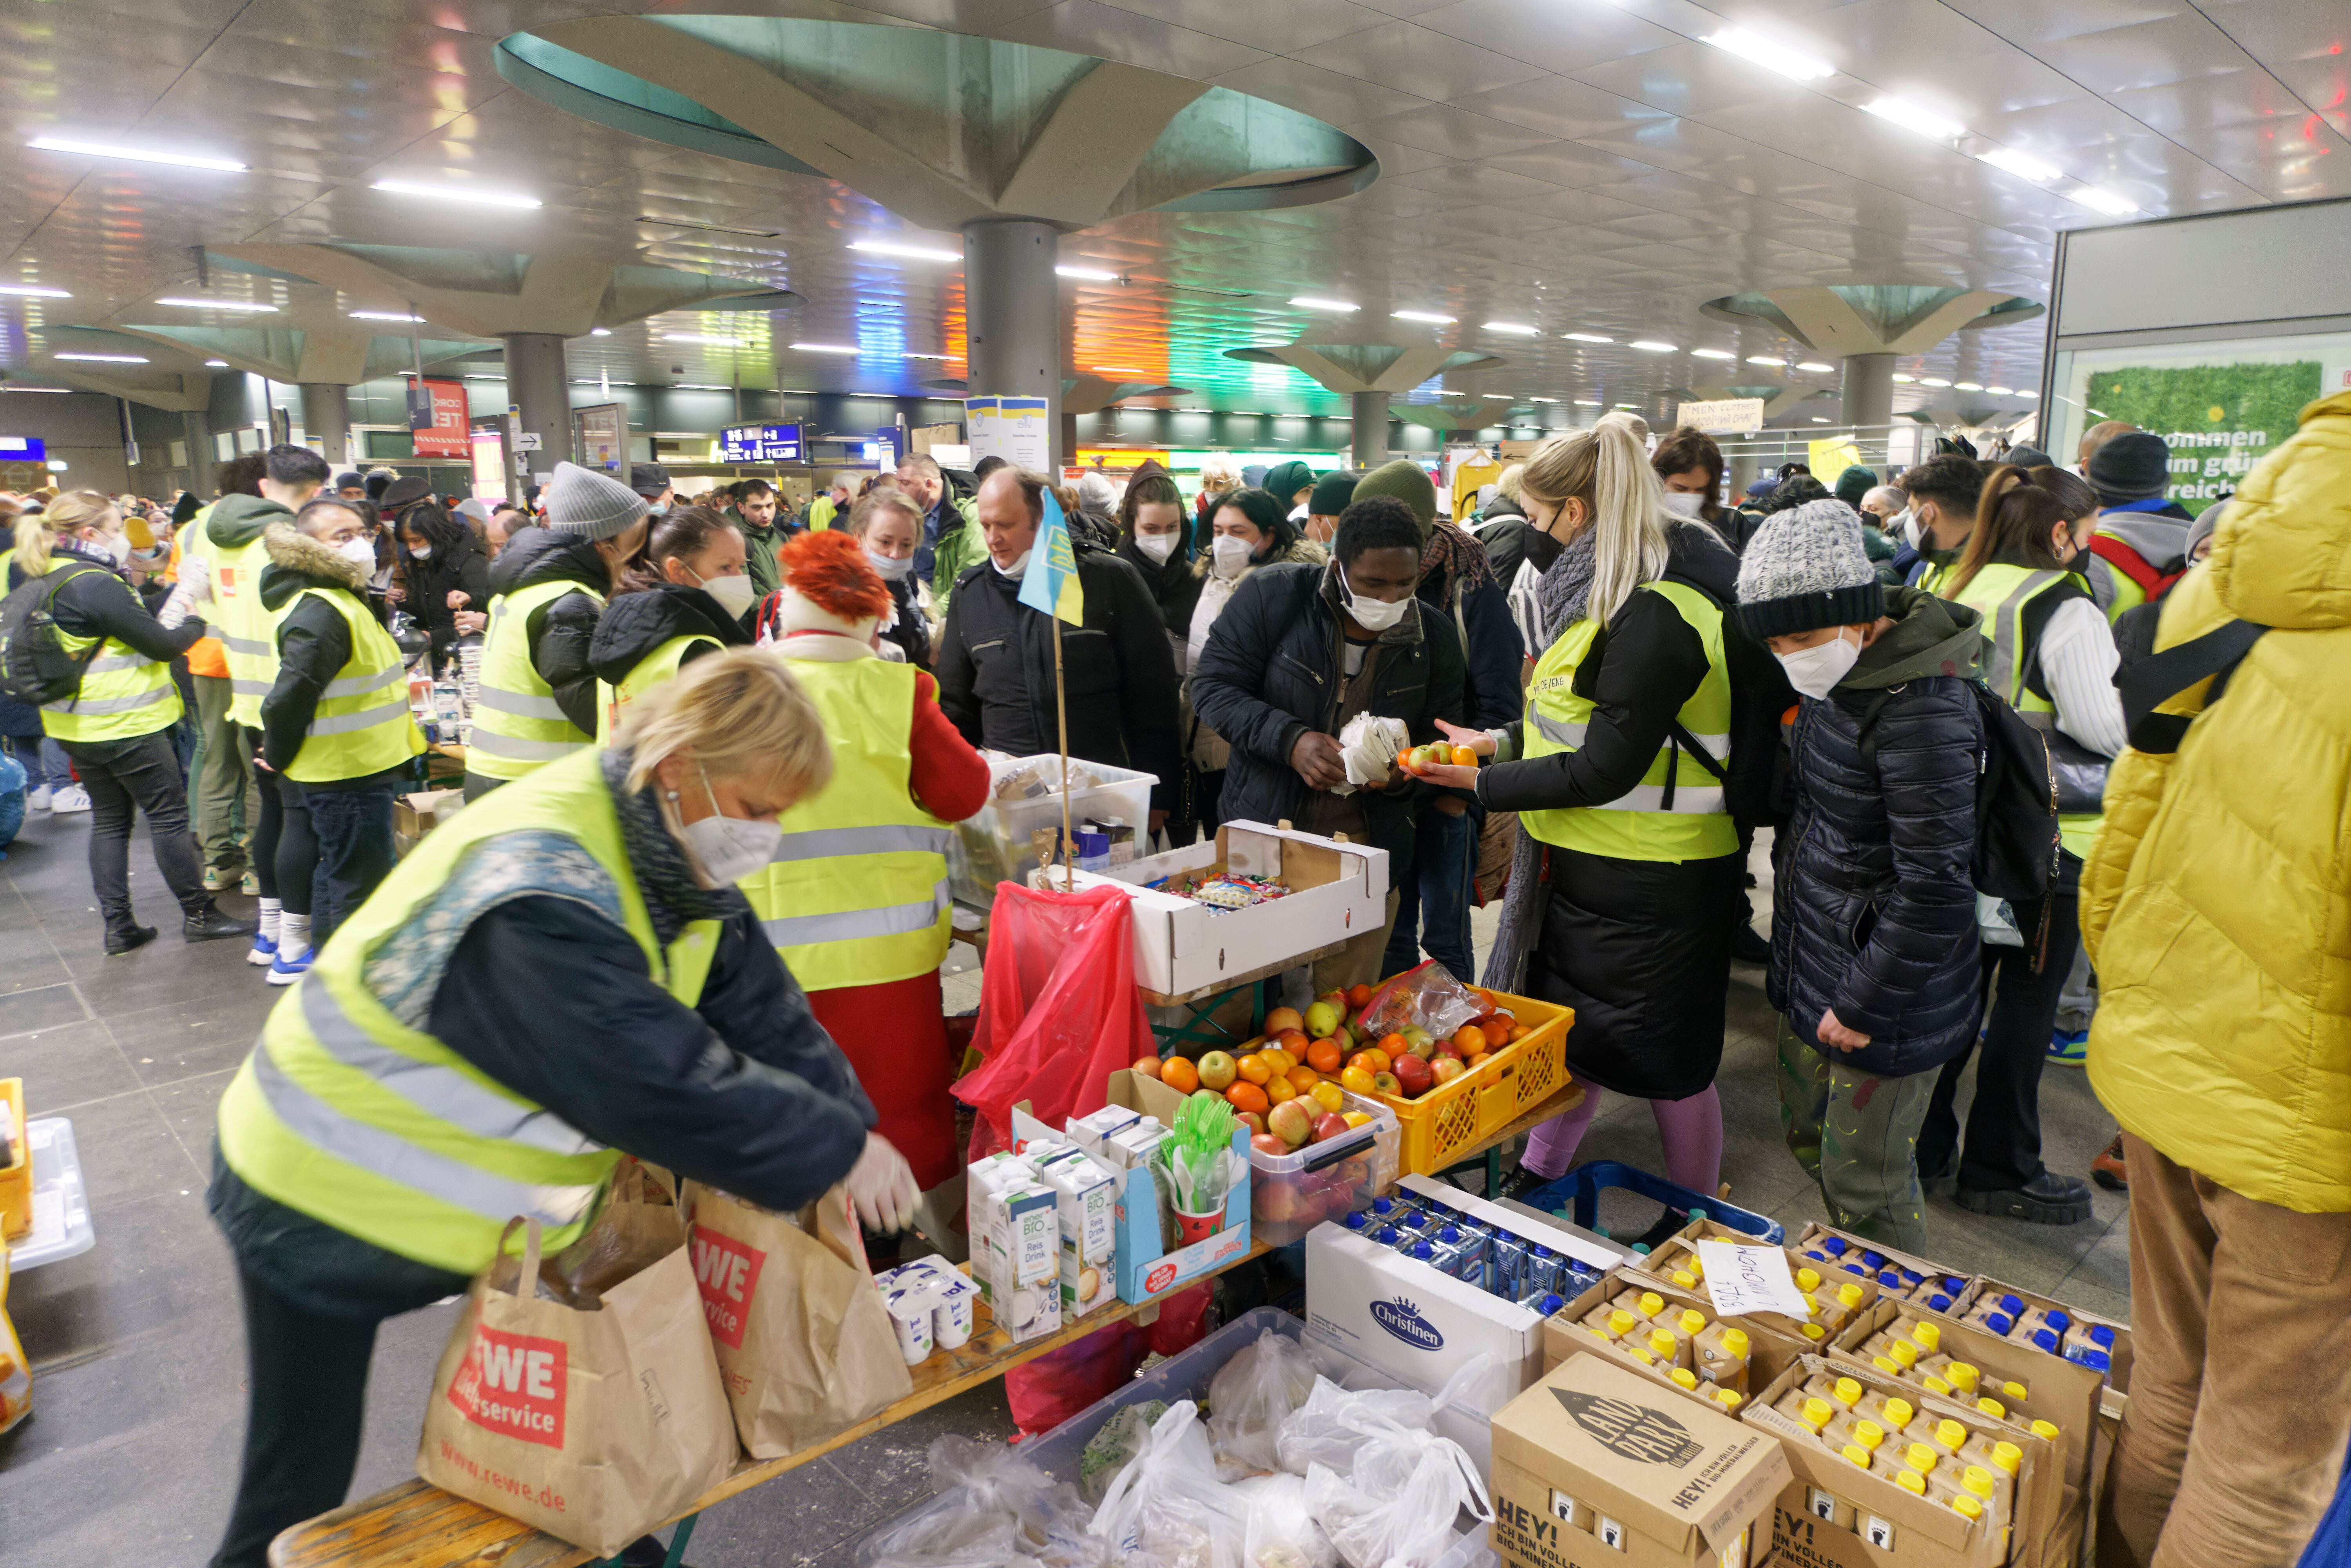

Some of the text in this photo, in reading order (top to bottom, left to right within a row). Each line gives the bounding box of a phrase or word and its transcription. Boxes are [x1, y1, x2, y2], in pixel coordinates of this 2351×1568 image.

[692, 1235, 750, 1304] WE
[1025, 1250, 1046, 1262] Drink
[1027, 1242, 1043, 1252] Reis
[1375, 1304, 1438, 1346] Christinen
[1567, 1396, 1645, 1444] LAND
[1615, 1414, 1695, 1467] PARK
[1699, 1466, 1712, 1478] ICH
[1716, 1444, 1738, 1462] VOLLER
[1709, 1436, 1760, 1483] BIO-MINERALWASSER
[1671, 1478, 1712, 1510] HEY!
[1497, 1521, 1515, 1539] ICH
[1518, 1532, 1536, 1551] BIN
[1539, 1544, 1581, 1568] VOLLE
[1498, 1496, 1558, 1548] HEY!
